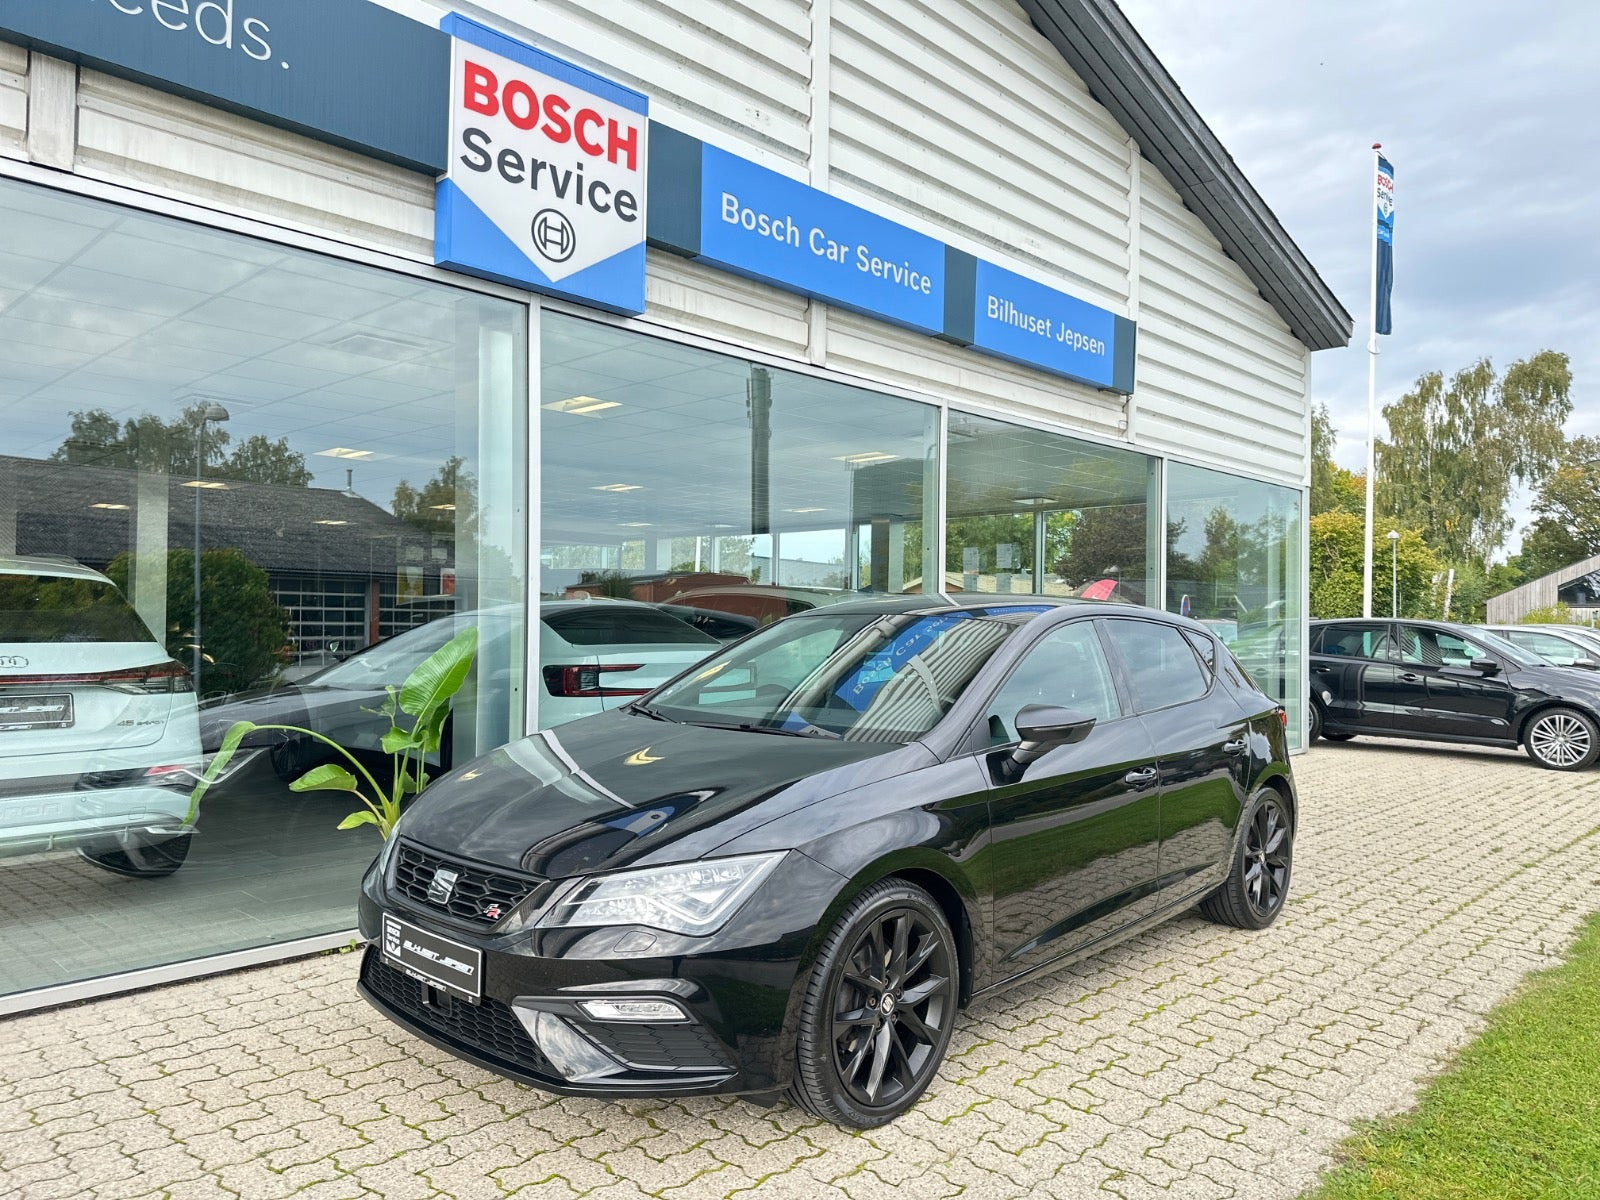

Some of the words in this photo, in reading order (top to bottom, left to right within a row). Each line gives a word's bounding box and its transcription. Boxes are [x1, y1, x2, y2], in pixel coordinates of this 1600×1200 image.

[463, 60, 638, 172] BOSCH
[460, 127, 639, 223] Service
[720, 191, 800, 248] Bosch
[808, 229, 850, 265] Car
[856, 245, 932, 295] Service
[987, 295, 1052, 339] Bilhuset
[1055, 321, 1106, 357] Jepsen
